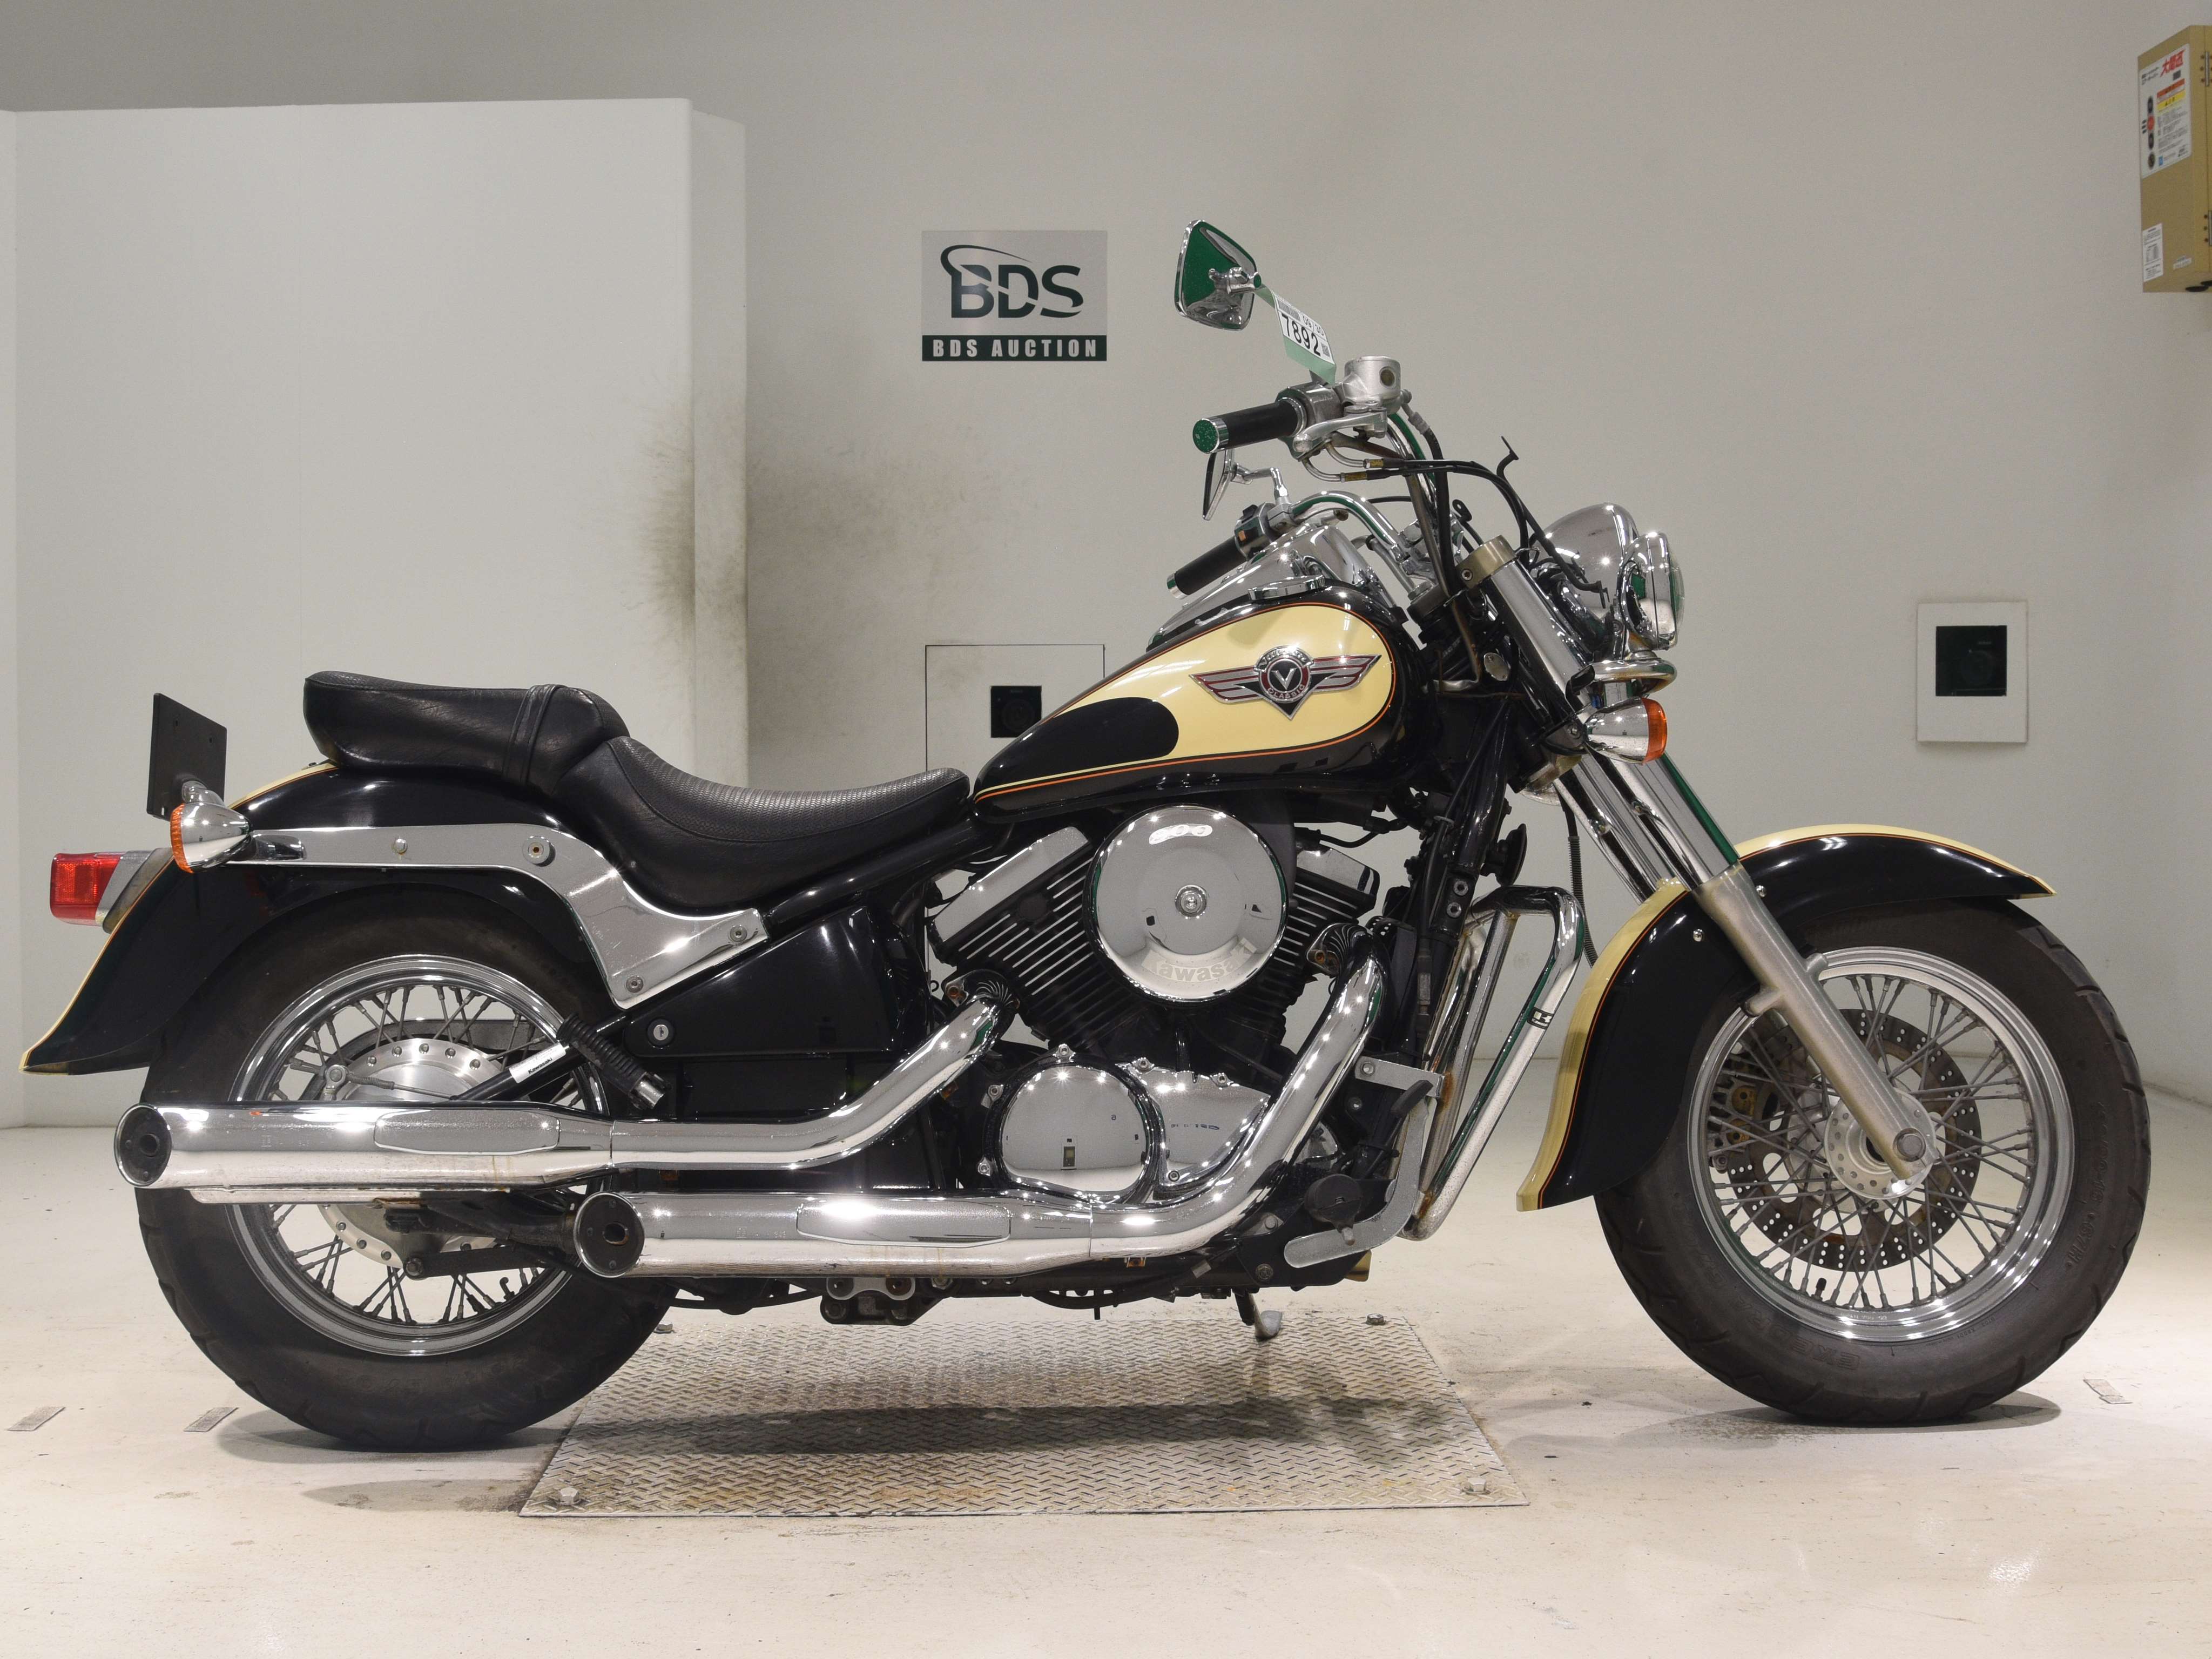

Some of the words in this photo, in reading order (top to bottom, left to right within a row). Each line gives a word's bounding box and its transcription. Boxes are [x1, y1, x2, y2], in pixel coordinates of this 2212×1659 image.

[940, 245, 1083, 318] BDS
[1281, 312, 1321, 357] 7892
[933, 339, 978, 358] BDS
[991, 339, 1096, 358] AUCTION
[1271, 667, 1298, 691] V
[1267, 684, 1305, 699] CLASSIC
[528, 1057, 553, 1074] Kawasaki
